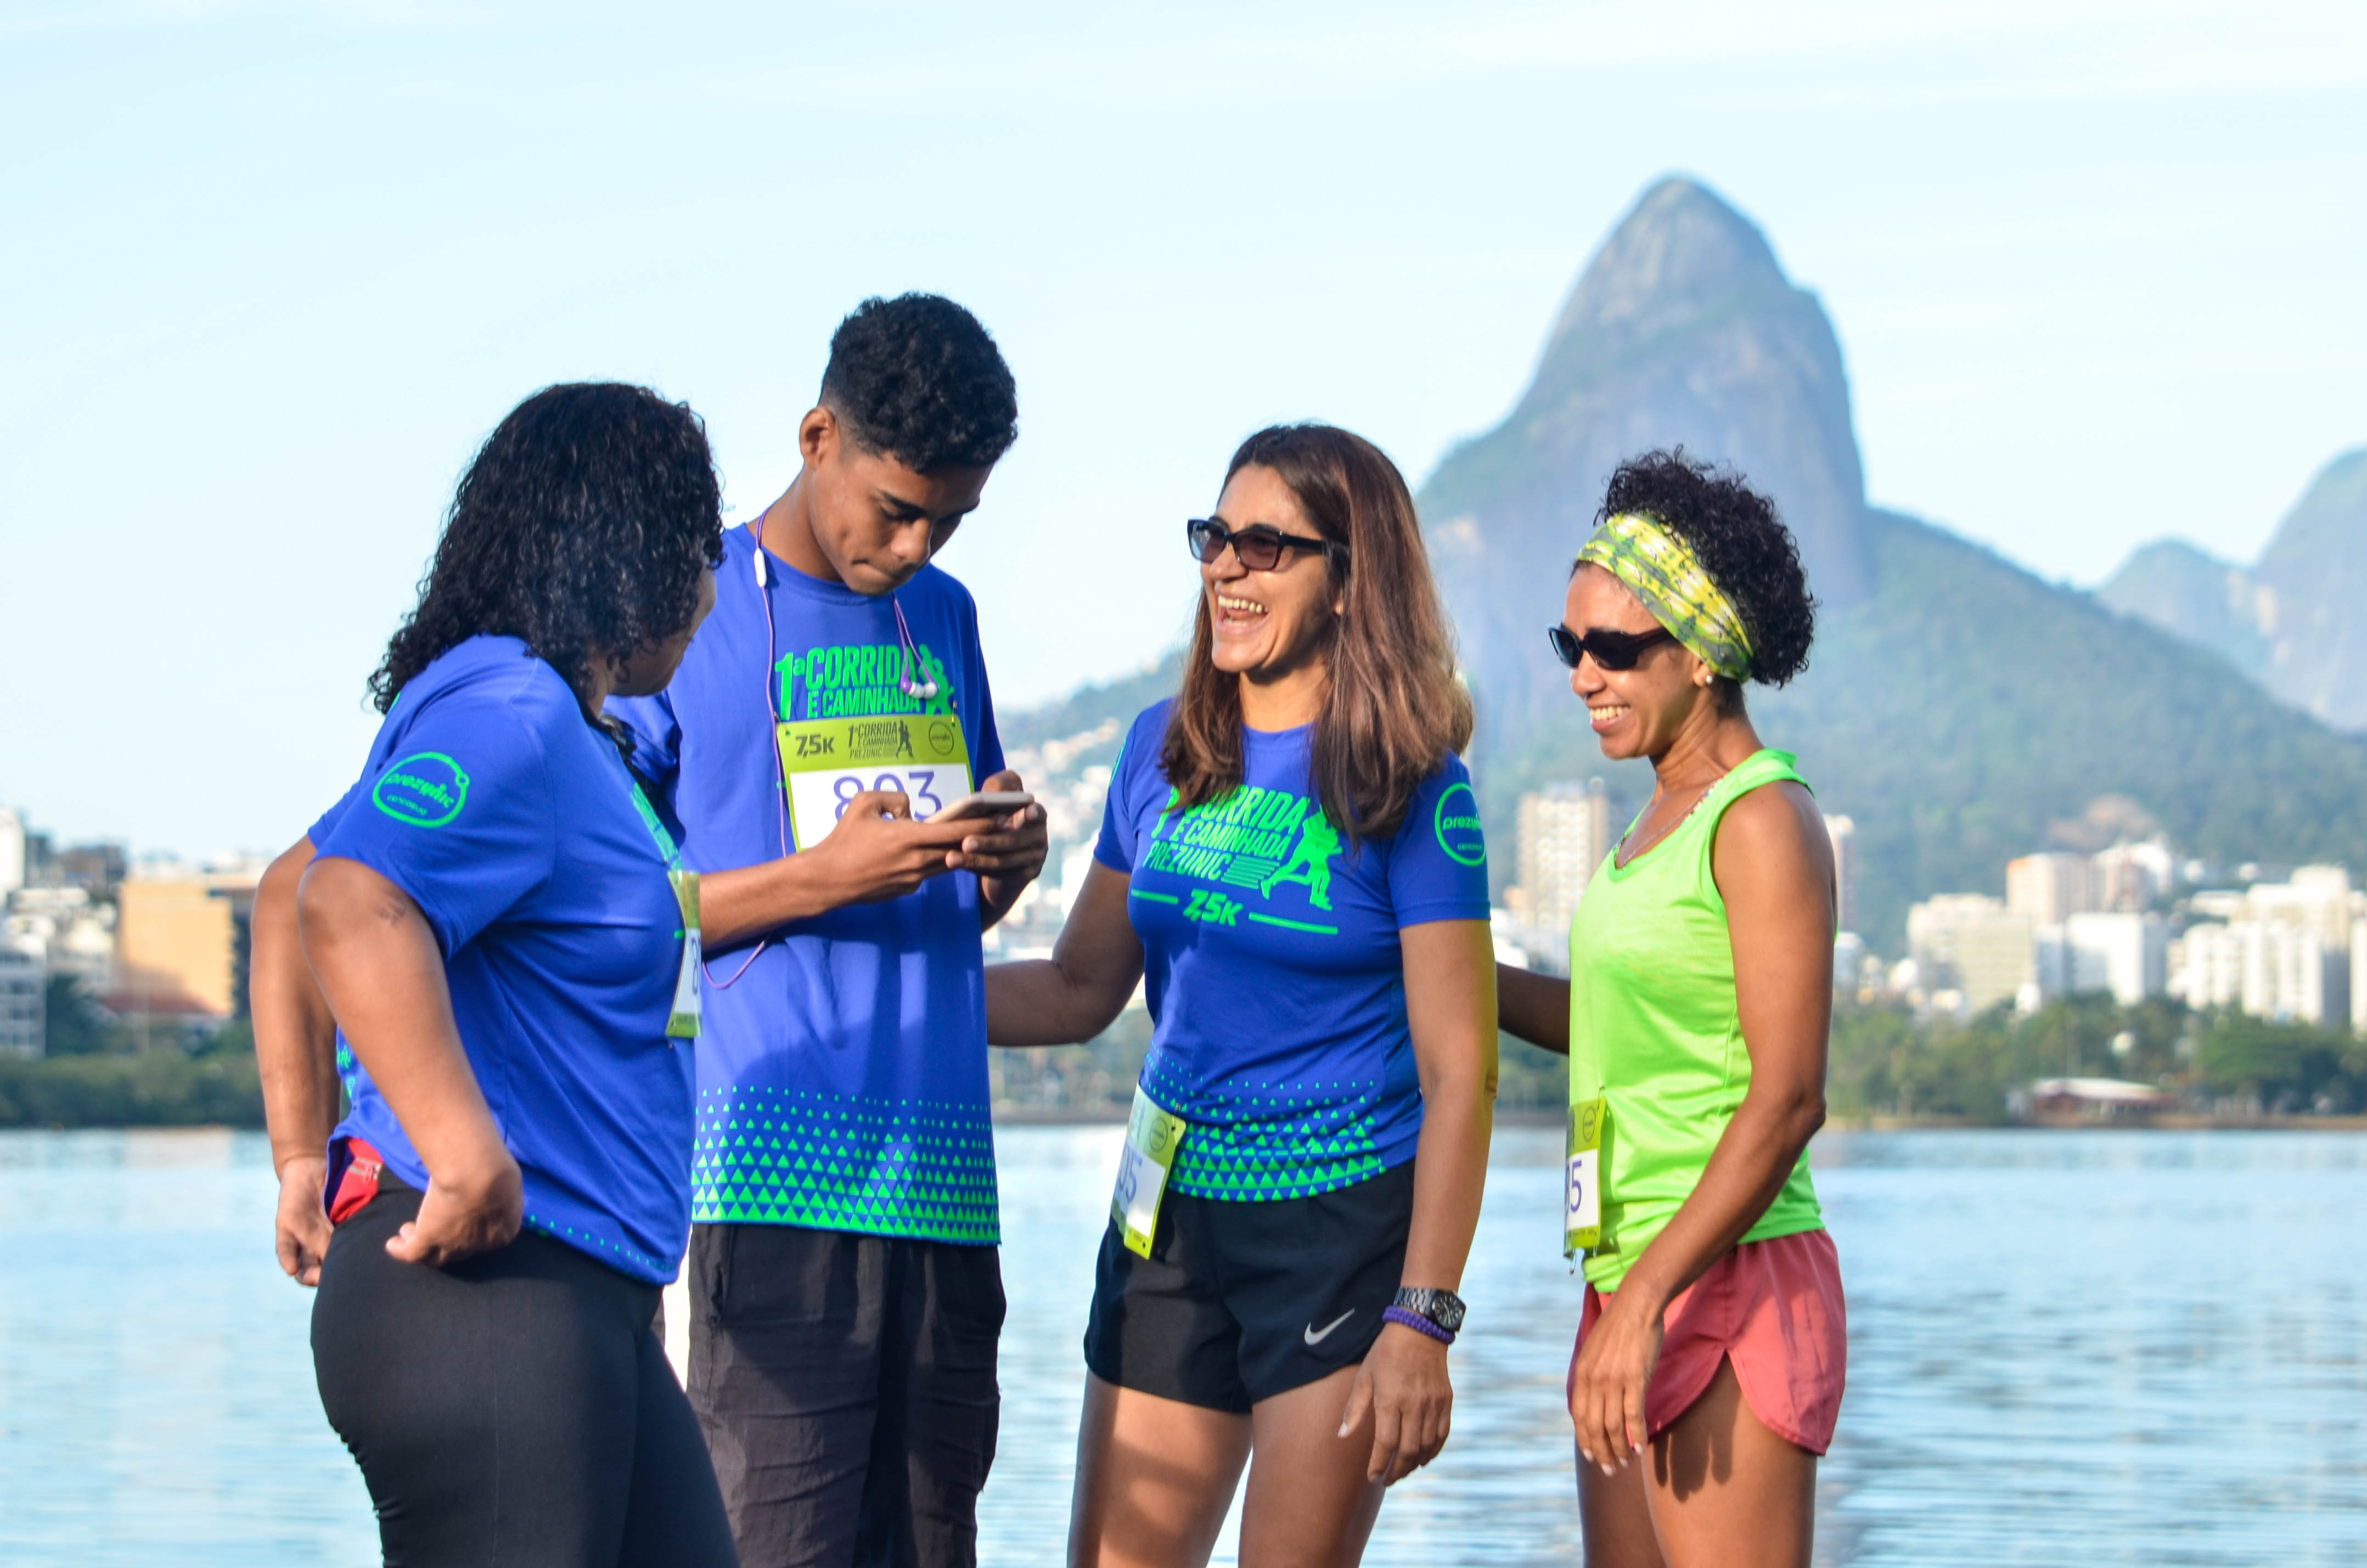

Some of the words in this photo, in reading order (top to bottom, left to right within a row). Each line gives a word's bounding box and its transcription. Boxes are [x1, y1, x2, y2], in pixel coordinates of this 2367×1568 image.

[805, 644, 918, 690] CORRIDA
[807, 690, 819, 718] E
[822, 686, 920, 717] CAMINHADA
[858, 721, 898, 738] CORRIDA
[863, 735, 898, 745] CAMINHADA
[796, 734, 835, 758] 7,5K
[850, 747, 882, 760] PREZUNIC
[1169, 817, 1191, 841] E
[1183, 819, 1292, 860] CAMINHADA
[1143, 839, 1232, 881] PREZUNIC
